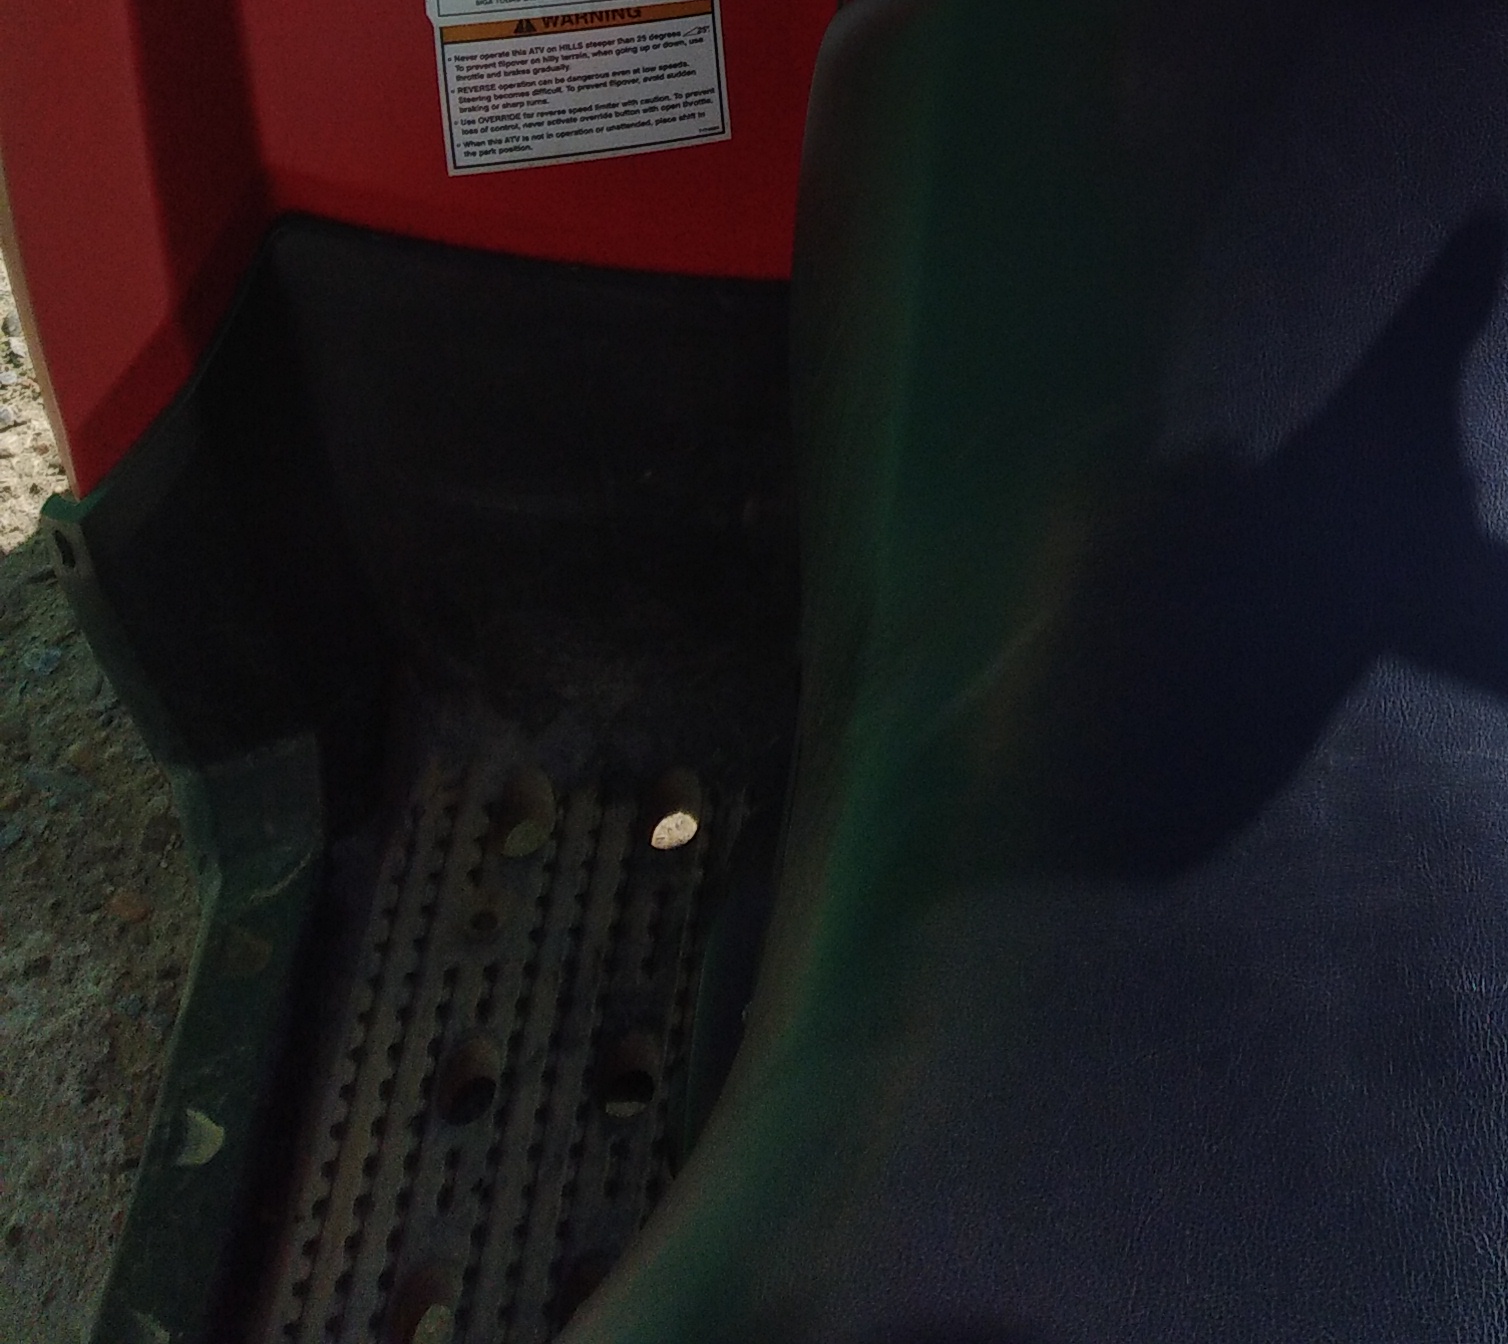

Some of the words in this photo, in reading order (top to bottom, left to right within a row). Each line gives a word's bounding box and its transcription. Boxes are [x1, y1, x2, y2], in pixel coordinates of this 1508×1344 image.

[542, 7, 642, 28] WARNING
[454, 55, 477, 63] Never
[480, 52, 509, 61] operate
[512, 49, 526, 57] this
[529, 46, 544, 55] ATV
[559, 42, 583, 51] HILLS
[585, 39, 615, 49] steeper
[617, 37, 635, 45] than
[649, 31, 681, 41] degrees
[466, 63, 496, 72] prevent
[615, 46, 638, 56] going
[456, 73, 484, 81] throttle
[504, 68, 530, 77] brakes
[457, 84, 496, 94] REVERSE
[498, 80, 536, 91] operation
[567, 72, 609, 83] dangerous
